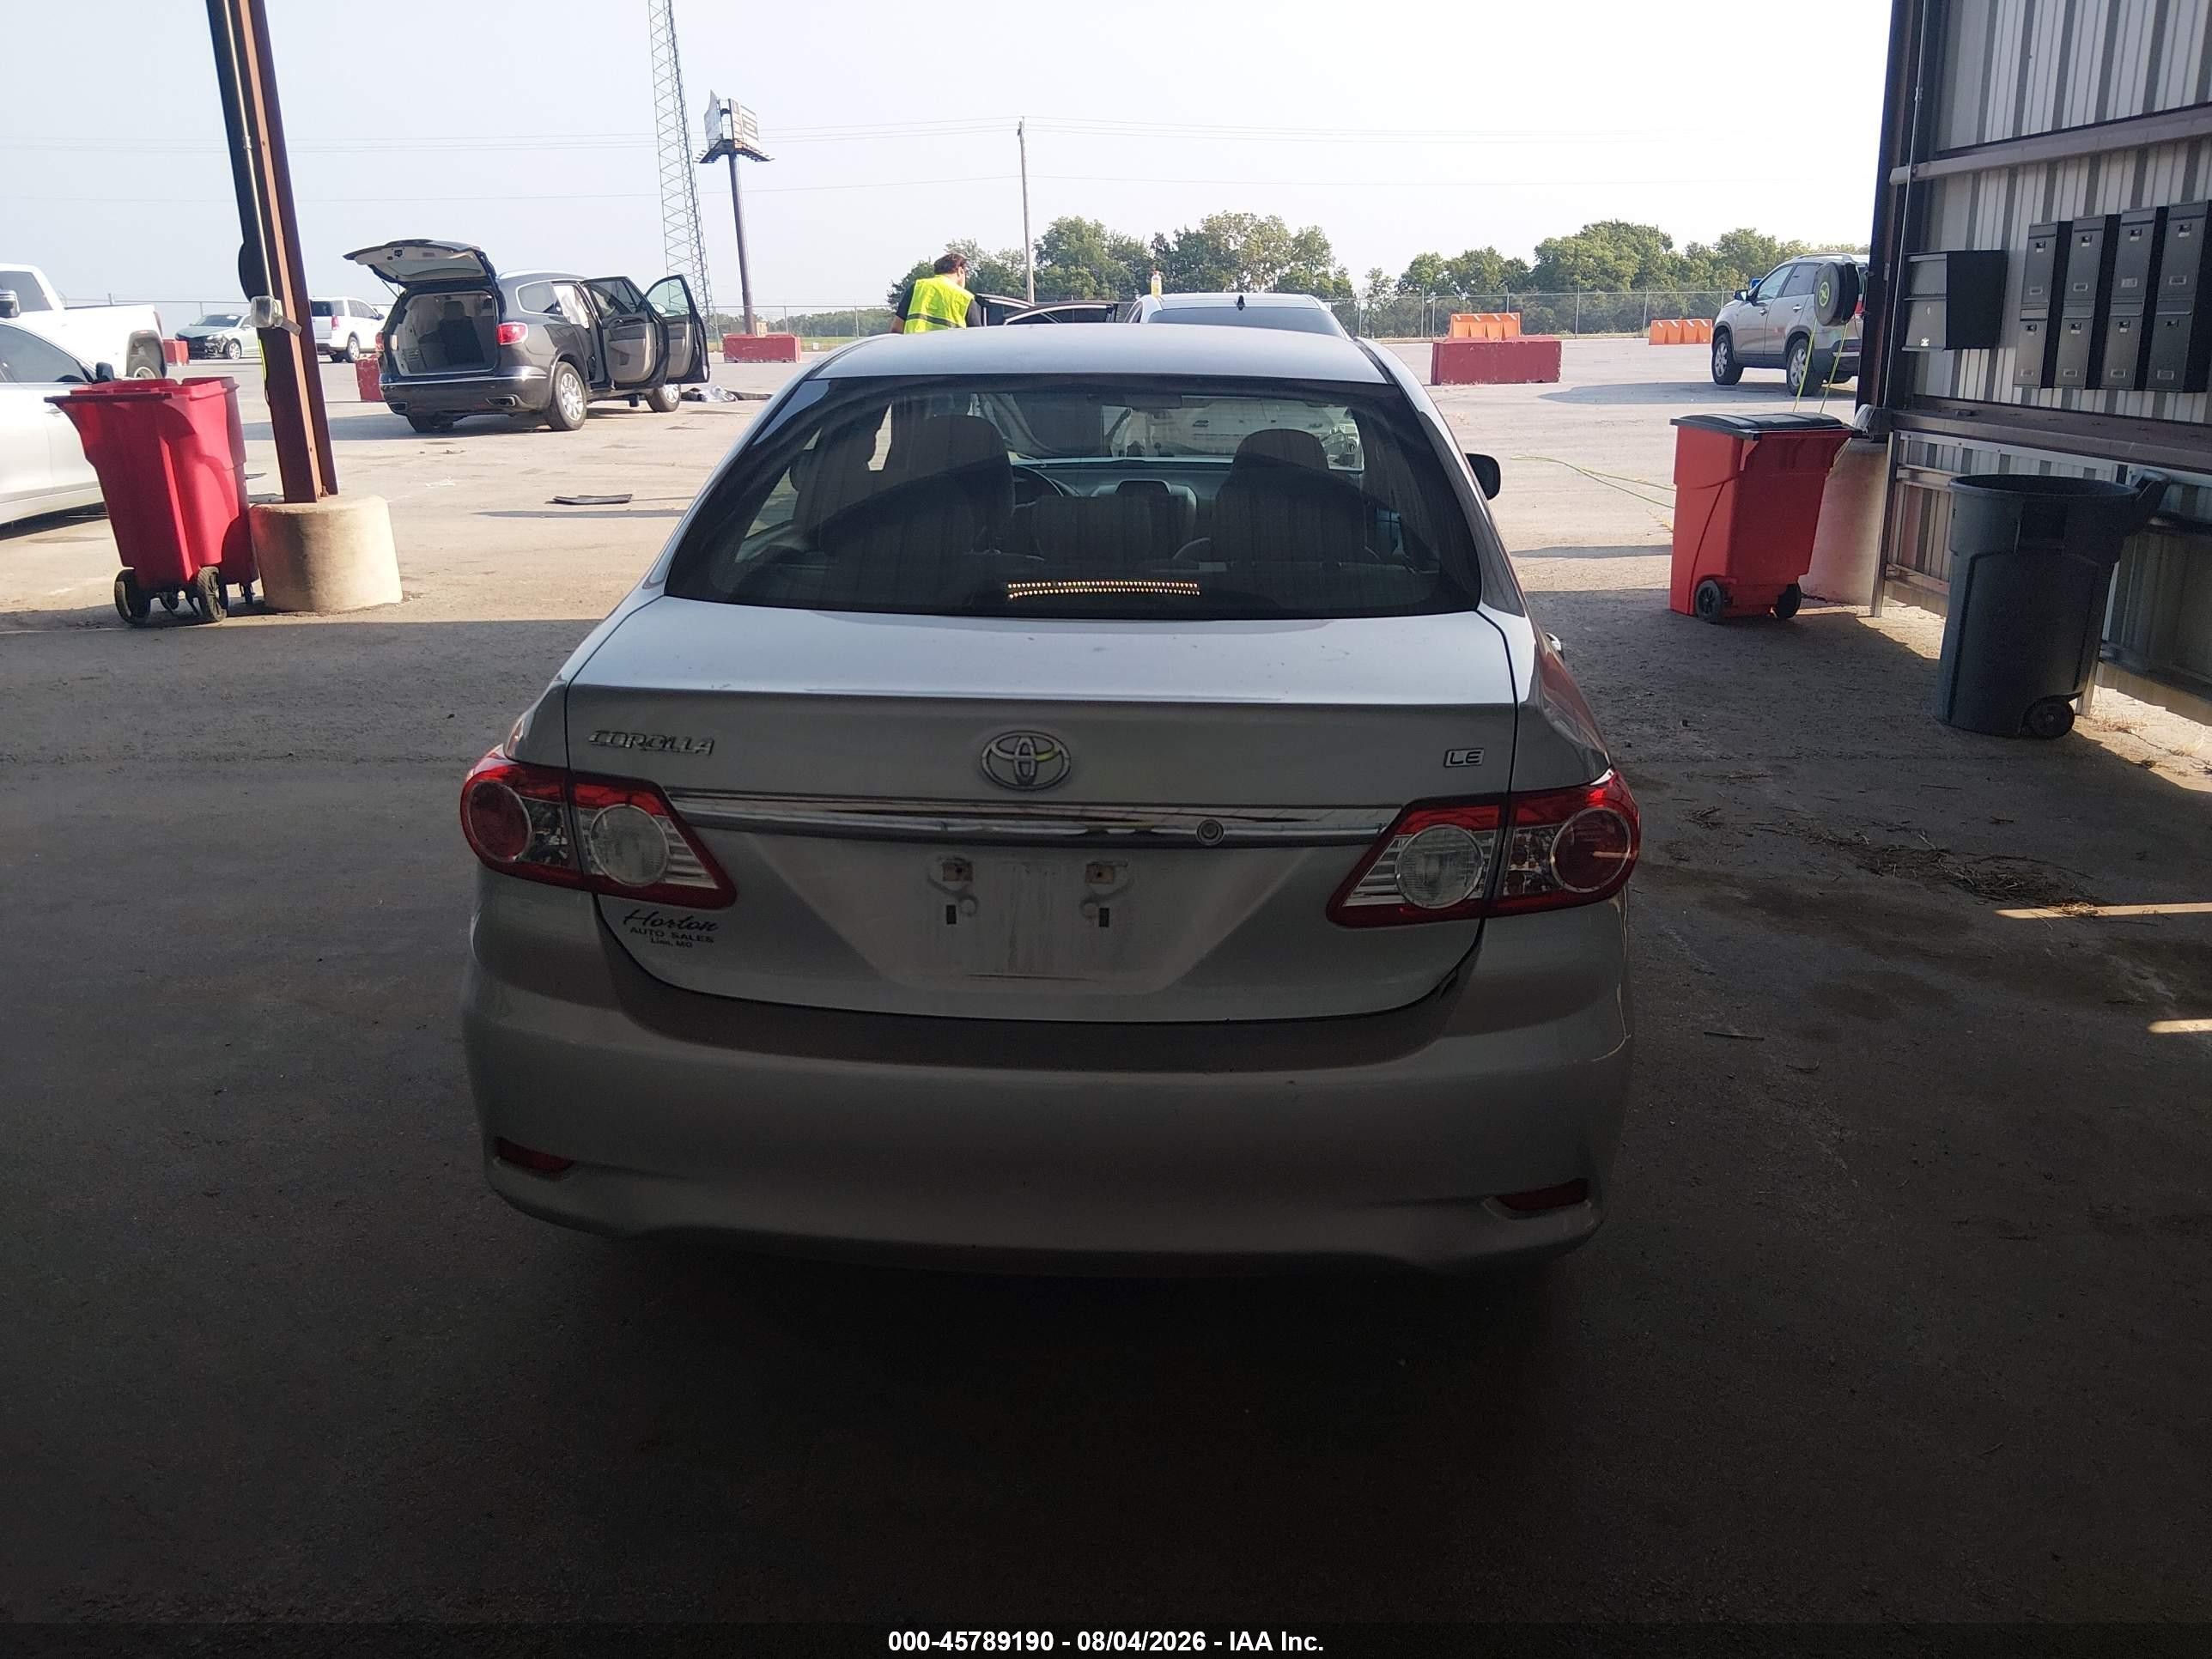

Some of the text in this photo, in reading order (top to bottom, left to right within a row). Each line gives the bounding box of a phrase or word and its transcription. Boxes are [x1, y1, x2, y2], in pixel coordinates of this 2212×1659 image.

[589, 731, 715, 756] COROLLA
[1449, 750, 1482, 765] LE
[623, 908, 719, 932] Horton
[630, 927, 714, 943] AUTO SALES
